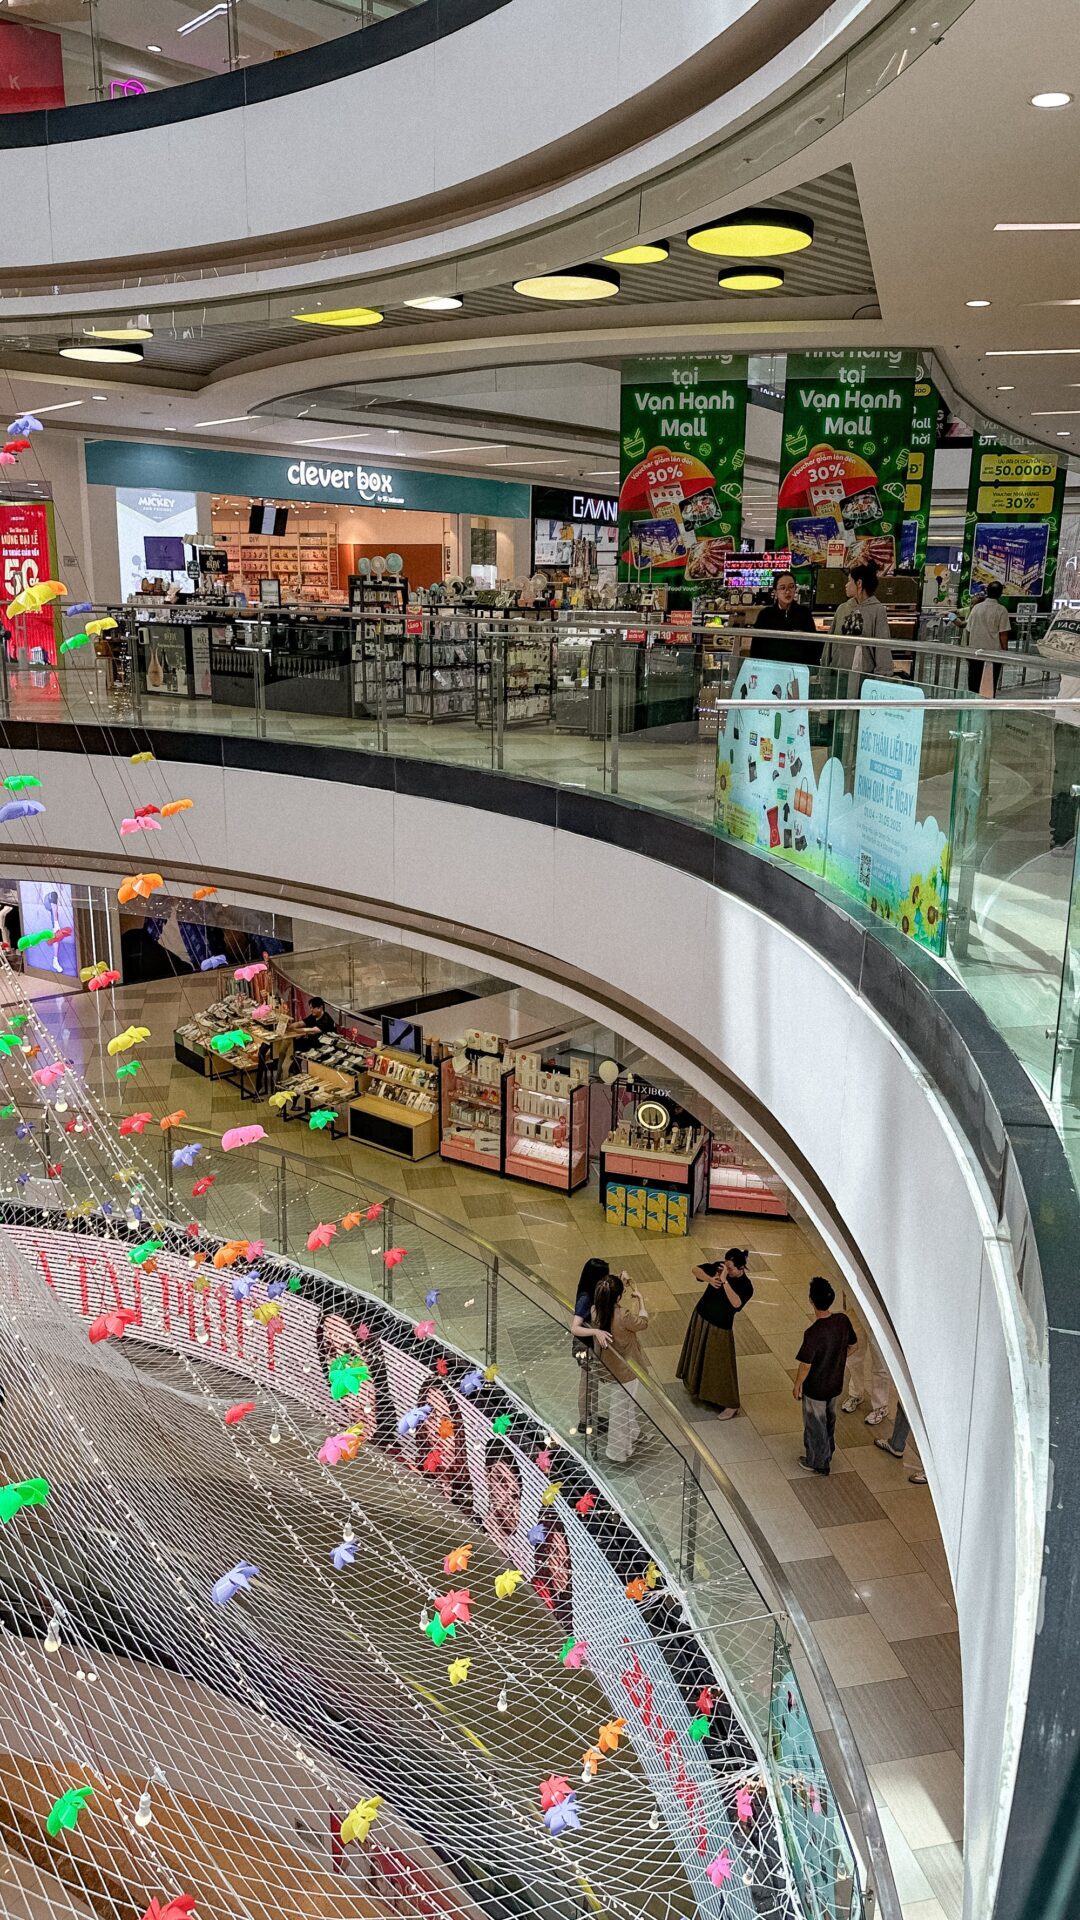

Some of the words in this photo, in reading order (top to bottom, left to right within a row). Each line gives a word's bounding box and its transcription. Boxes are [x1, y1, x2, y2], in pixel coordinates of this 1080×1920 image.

[672, 366, 698, 389] tại
[839, 365, 866, 387] tại
[635, 393, 674, 415] Vạn
[680, 390, 734, 414] Hạnh
[800, 390, 839, 413] Vạn
[845, 389, 902, 413] Hạnh
[661, 417, 707, 436] Mall
[825, 416, 872, 435] Mall
[287, 461, 354, 489] clever
[357, 466, 392, 493] box
[646, 464, 684, 485] 30%
[138, 497, 175, 507] MICKEY
[905, 742, 918, 765] TAY
[895, 789, 914, 816] NGAY
[631, 1084, 671, 1097] LIXIBOX
